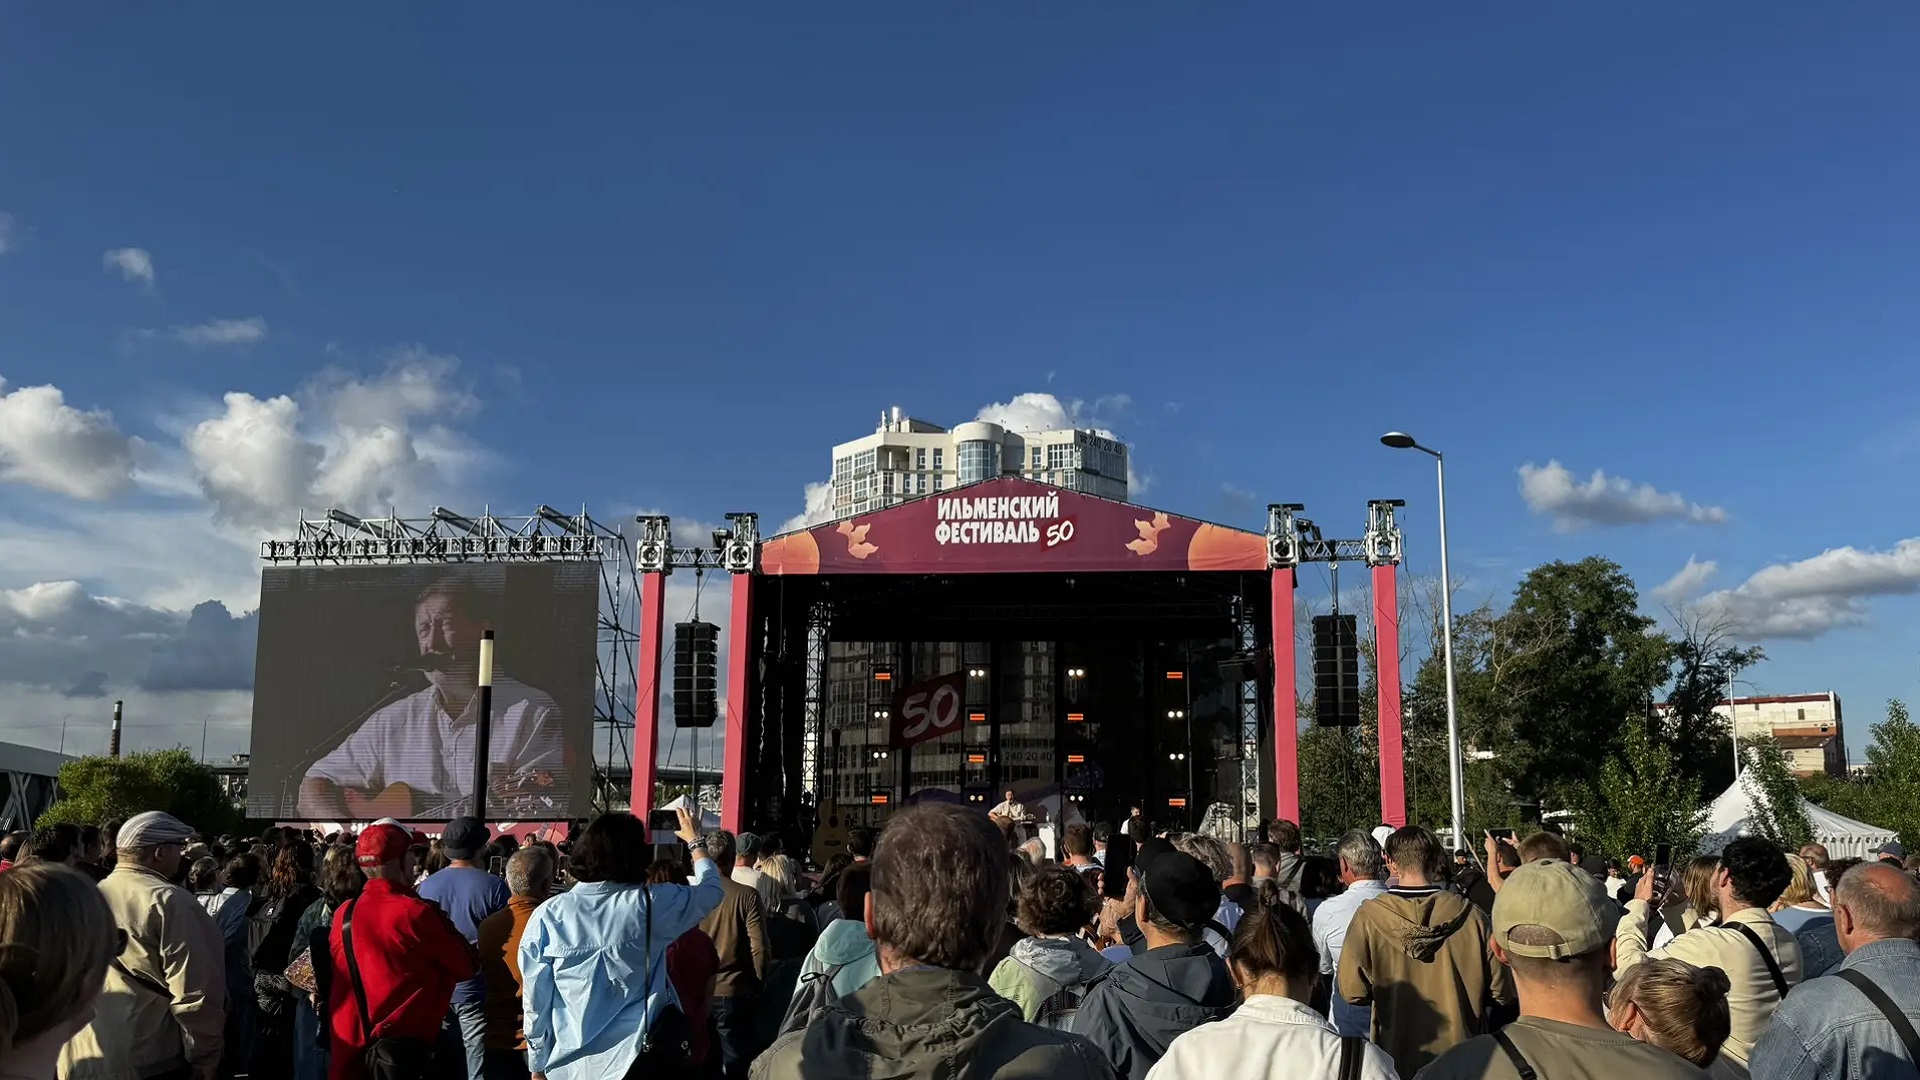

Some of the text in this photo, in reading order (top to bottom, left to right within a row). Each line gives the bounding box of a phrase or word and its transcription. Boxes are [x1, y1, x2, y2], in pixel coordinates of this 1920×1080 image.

[1089, 435, 1102, 449] 240
[1113, 443, 1122, 455] 40
[937, 490, 1059, 520] ИЛЬМЕНСКИЙ
[934, 520, 1074, 547] ФЕСТИВАЛЬ 50
[902, 684, 959, 738] 50
[1005, 751, 1052, 761] 240 20 40
